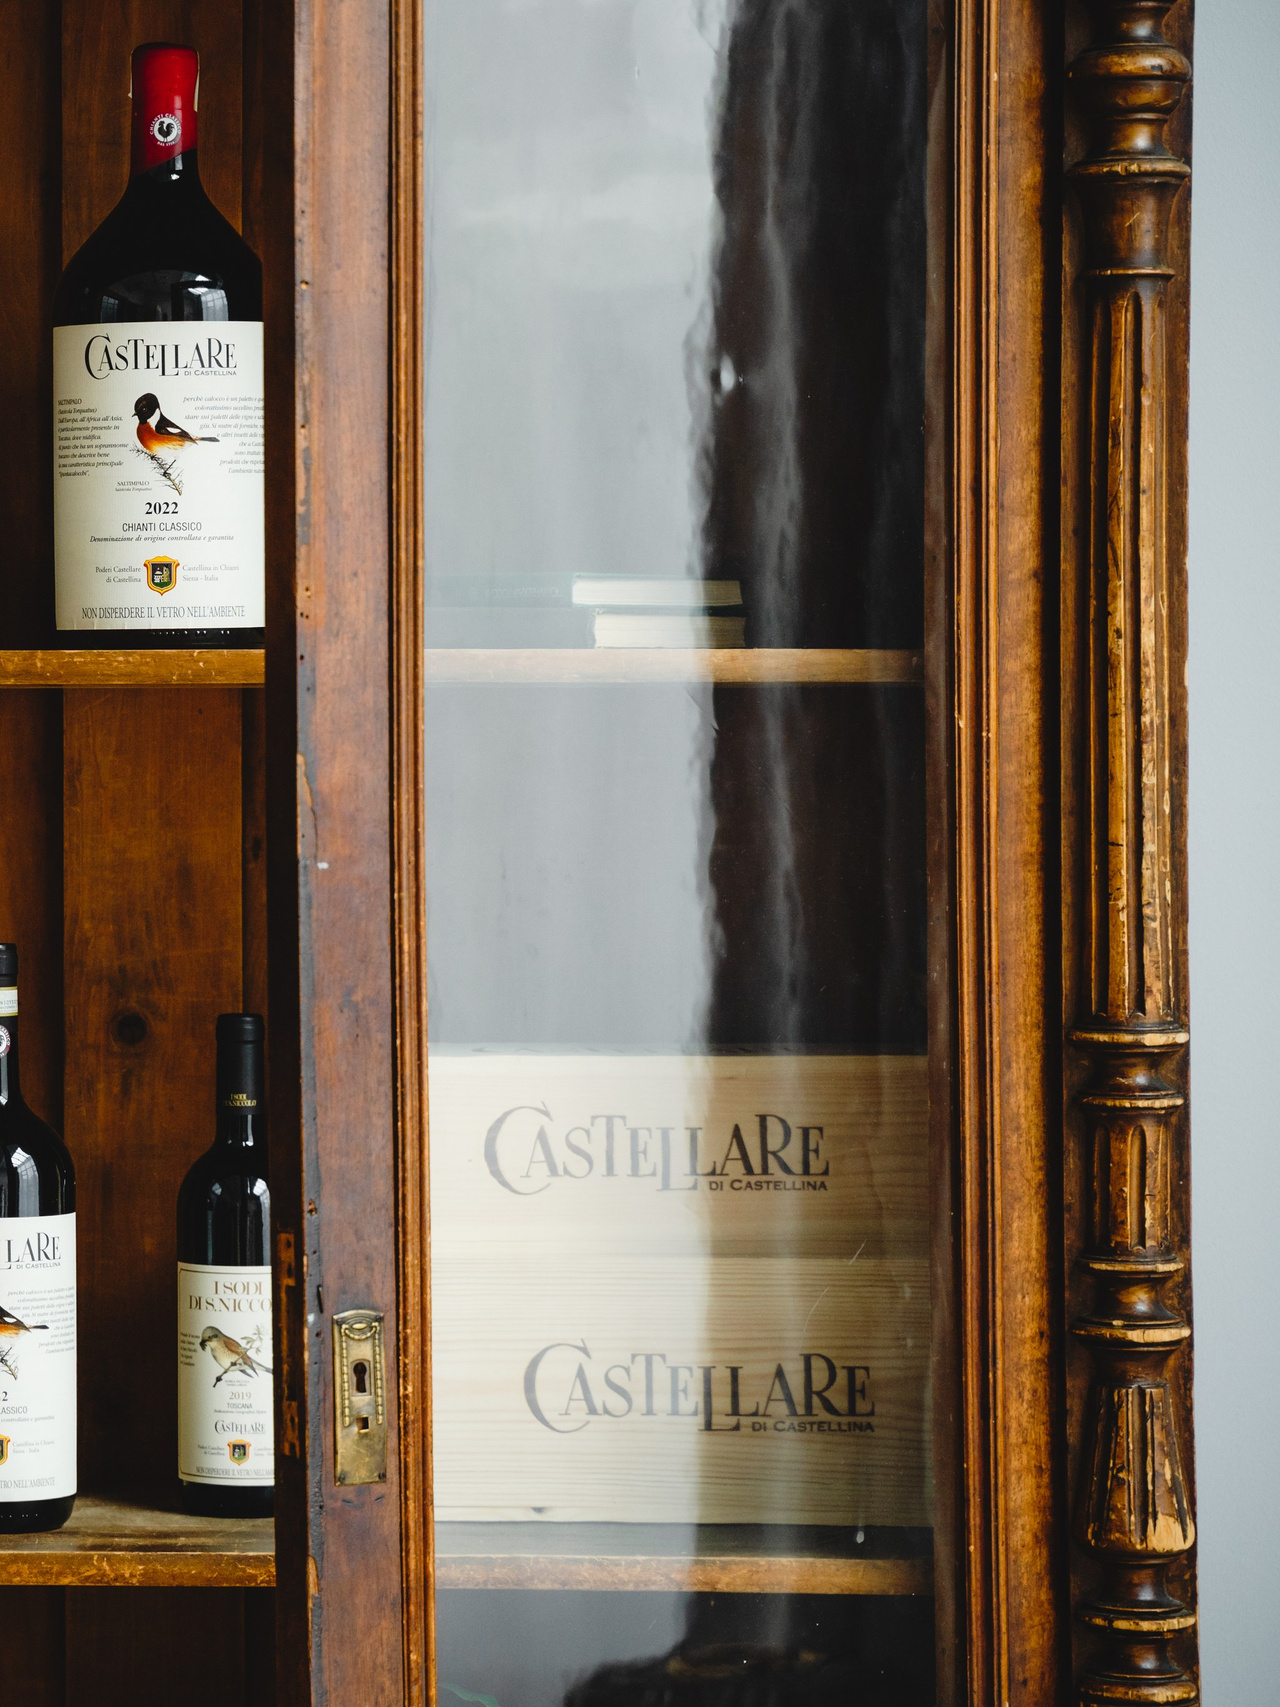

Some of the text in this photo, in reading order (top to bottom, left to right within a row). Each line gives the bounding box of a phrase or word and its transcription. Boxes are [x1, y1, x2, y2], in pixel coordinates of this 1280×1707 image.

[85, 333, 237, 380] CASTELLARE
[145, 502, 179, 515] 2022
[122, 522, 202, 532] CHIANTI CLASSICO
[90, 535, 133, 543] Denominazione
[144, 535, 166, 543] origine
[207, 534, 234, 542] garantita
[82, 605, 245, 619] NON DISPERDERE IL VETRO NELL'AMBIENTE
[483, 1101, 830, 1196] CASTELLARE
[708, 1178, 828, 1192] DI CASTELLINA
[214, 1281, 262, 1295] I SODI
[189, 1295, 202, 1310] DI
[523, 1338, 876, 1434] CASTELLARE
[229, 1391, 252, 1400] 2019
[214, 1420, 265, 1435] CASTELLARE
[751, 1419, 875, 1433] DI CASTELLINA
